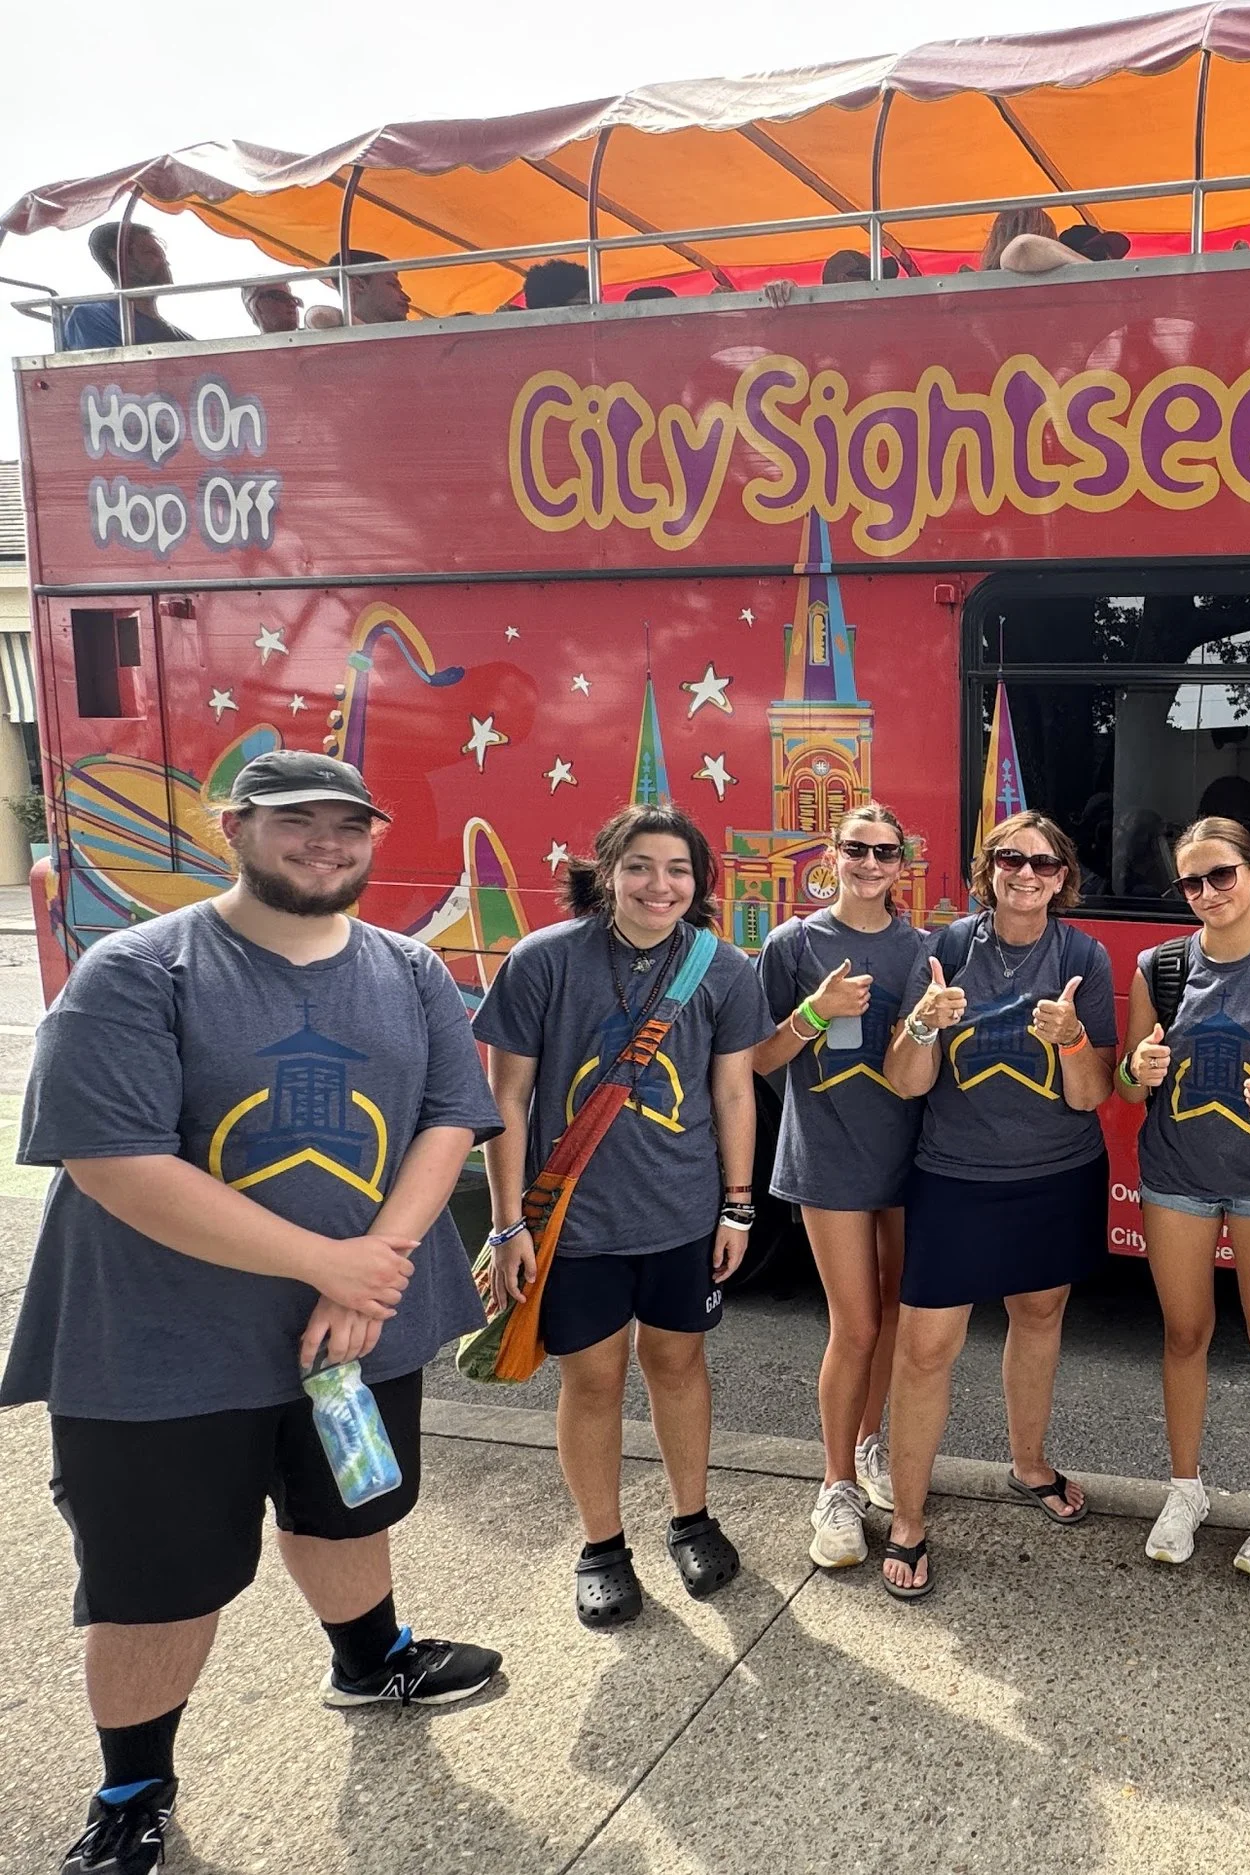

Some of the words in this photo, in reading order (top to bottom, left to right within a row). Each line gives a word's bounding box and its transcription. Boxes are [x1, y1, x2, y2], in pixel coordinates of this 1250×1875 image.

[84, 389, 183, 465] Hop
[194, 379, 264, 456] On
[93, 481, 188, 555] Hop
[201, 473, 280, 547] Off
